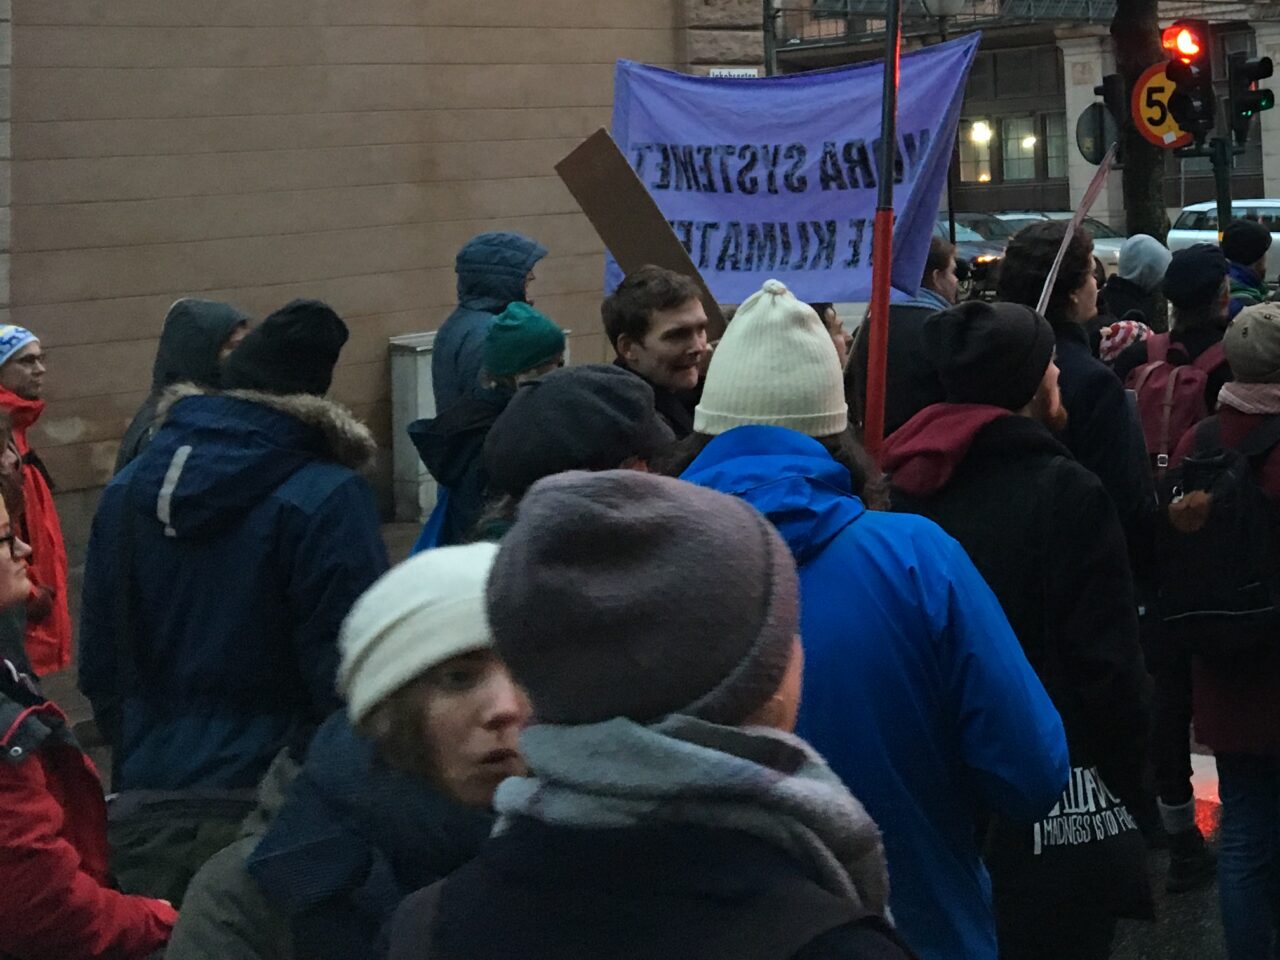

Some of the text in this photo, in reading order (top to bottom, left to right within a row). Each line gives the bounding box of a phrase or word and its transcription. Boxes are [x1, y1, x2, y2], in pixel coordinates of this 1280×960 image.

[1146, 86, 1168, 127] 5
[1043, 815, 1091, 846] MADNESS
[1092, 814, 1104, 840] IS
